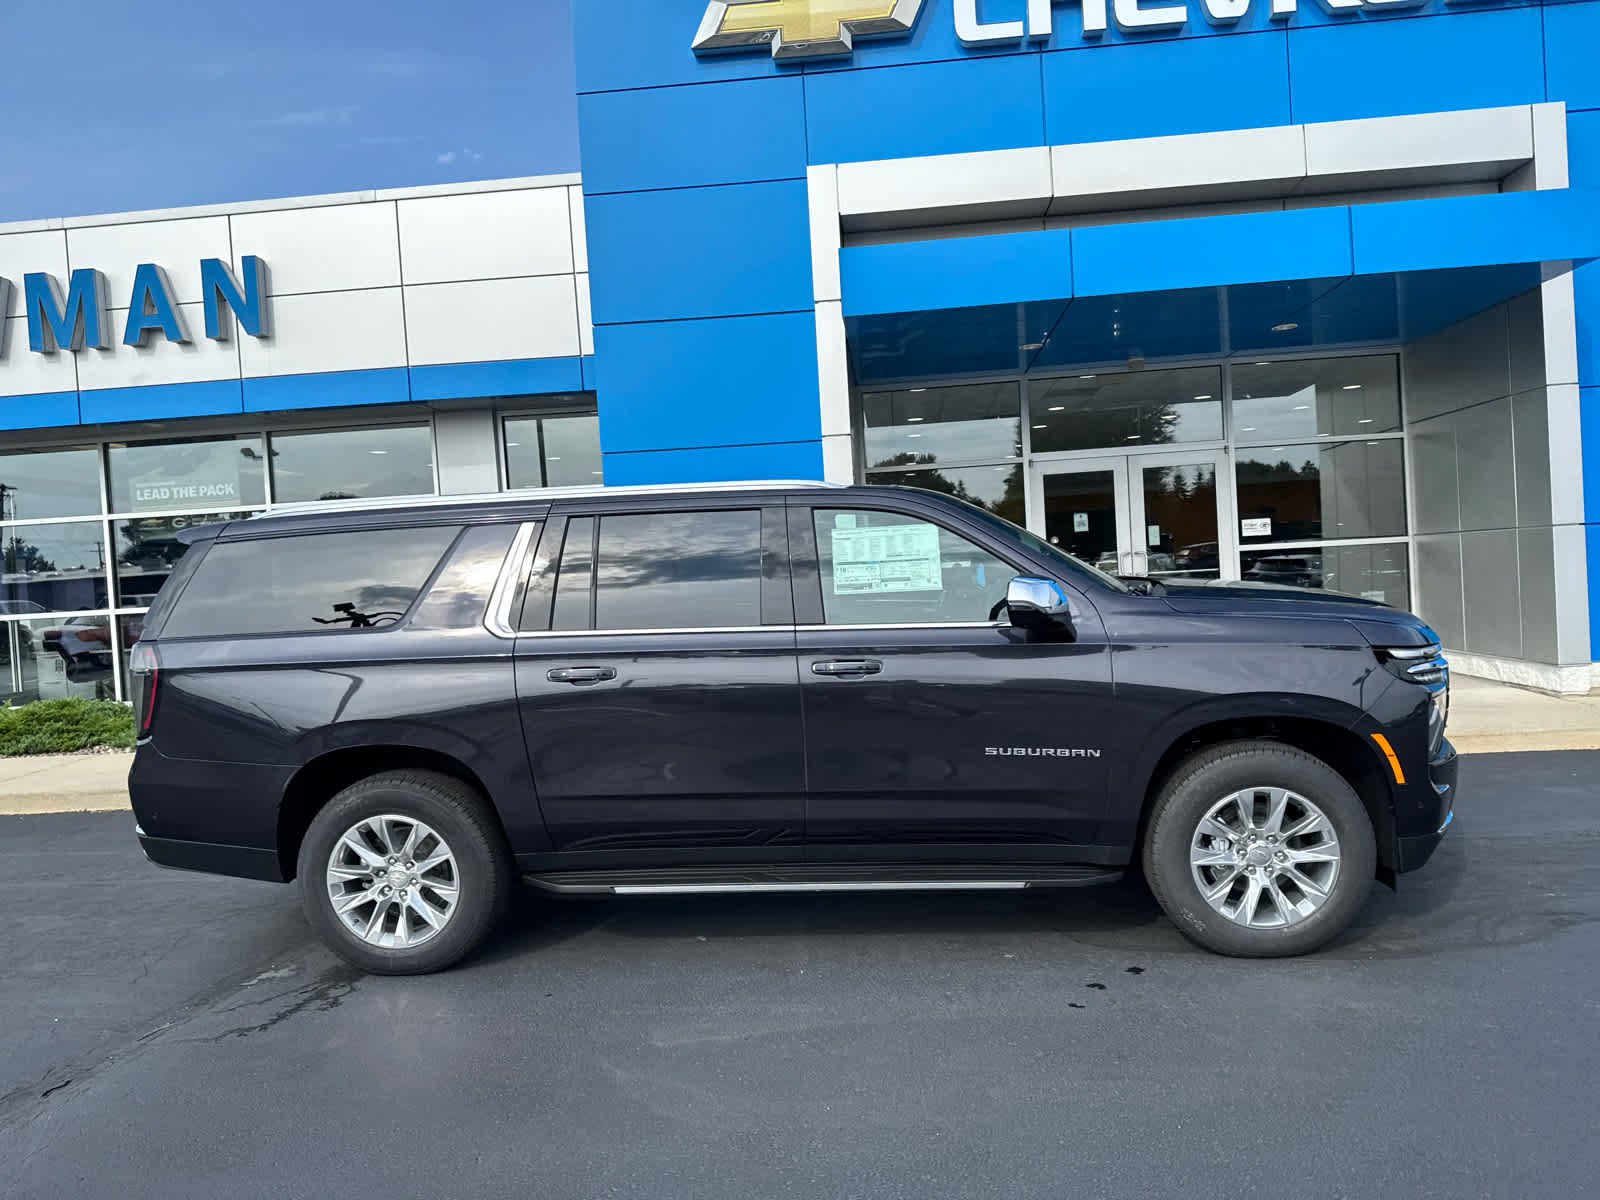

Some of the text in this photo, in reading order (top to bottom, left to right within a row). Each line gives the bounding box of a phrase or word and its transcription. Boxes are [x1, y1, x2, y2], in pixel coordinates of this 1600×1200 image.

[0, 254, 271, 353] MAN
[136, 483, 235, 501] LEAD THE PACK
[984, 747, 1101, 758] SUBURBAN
